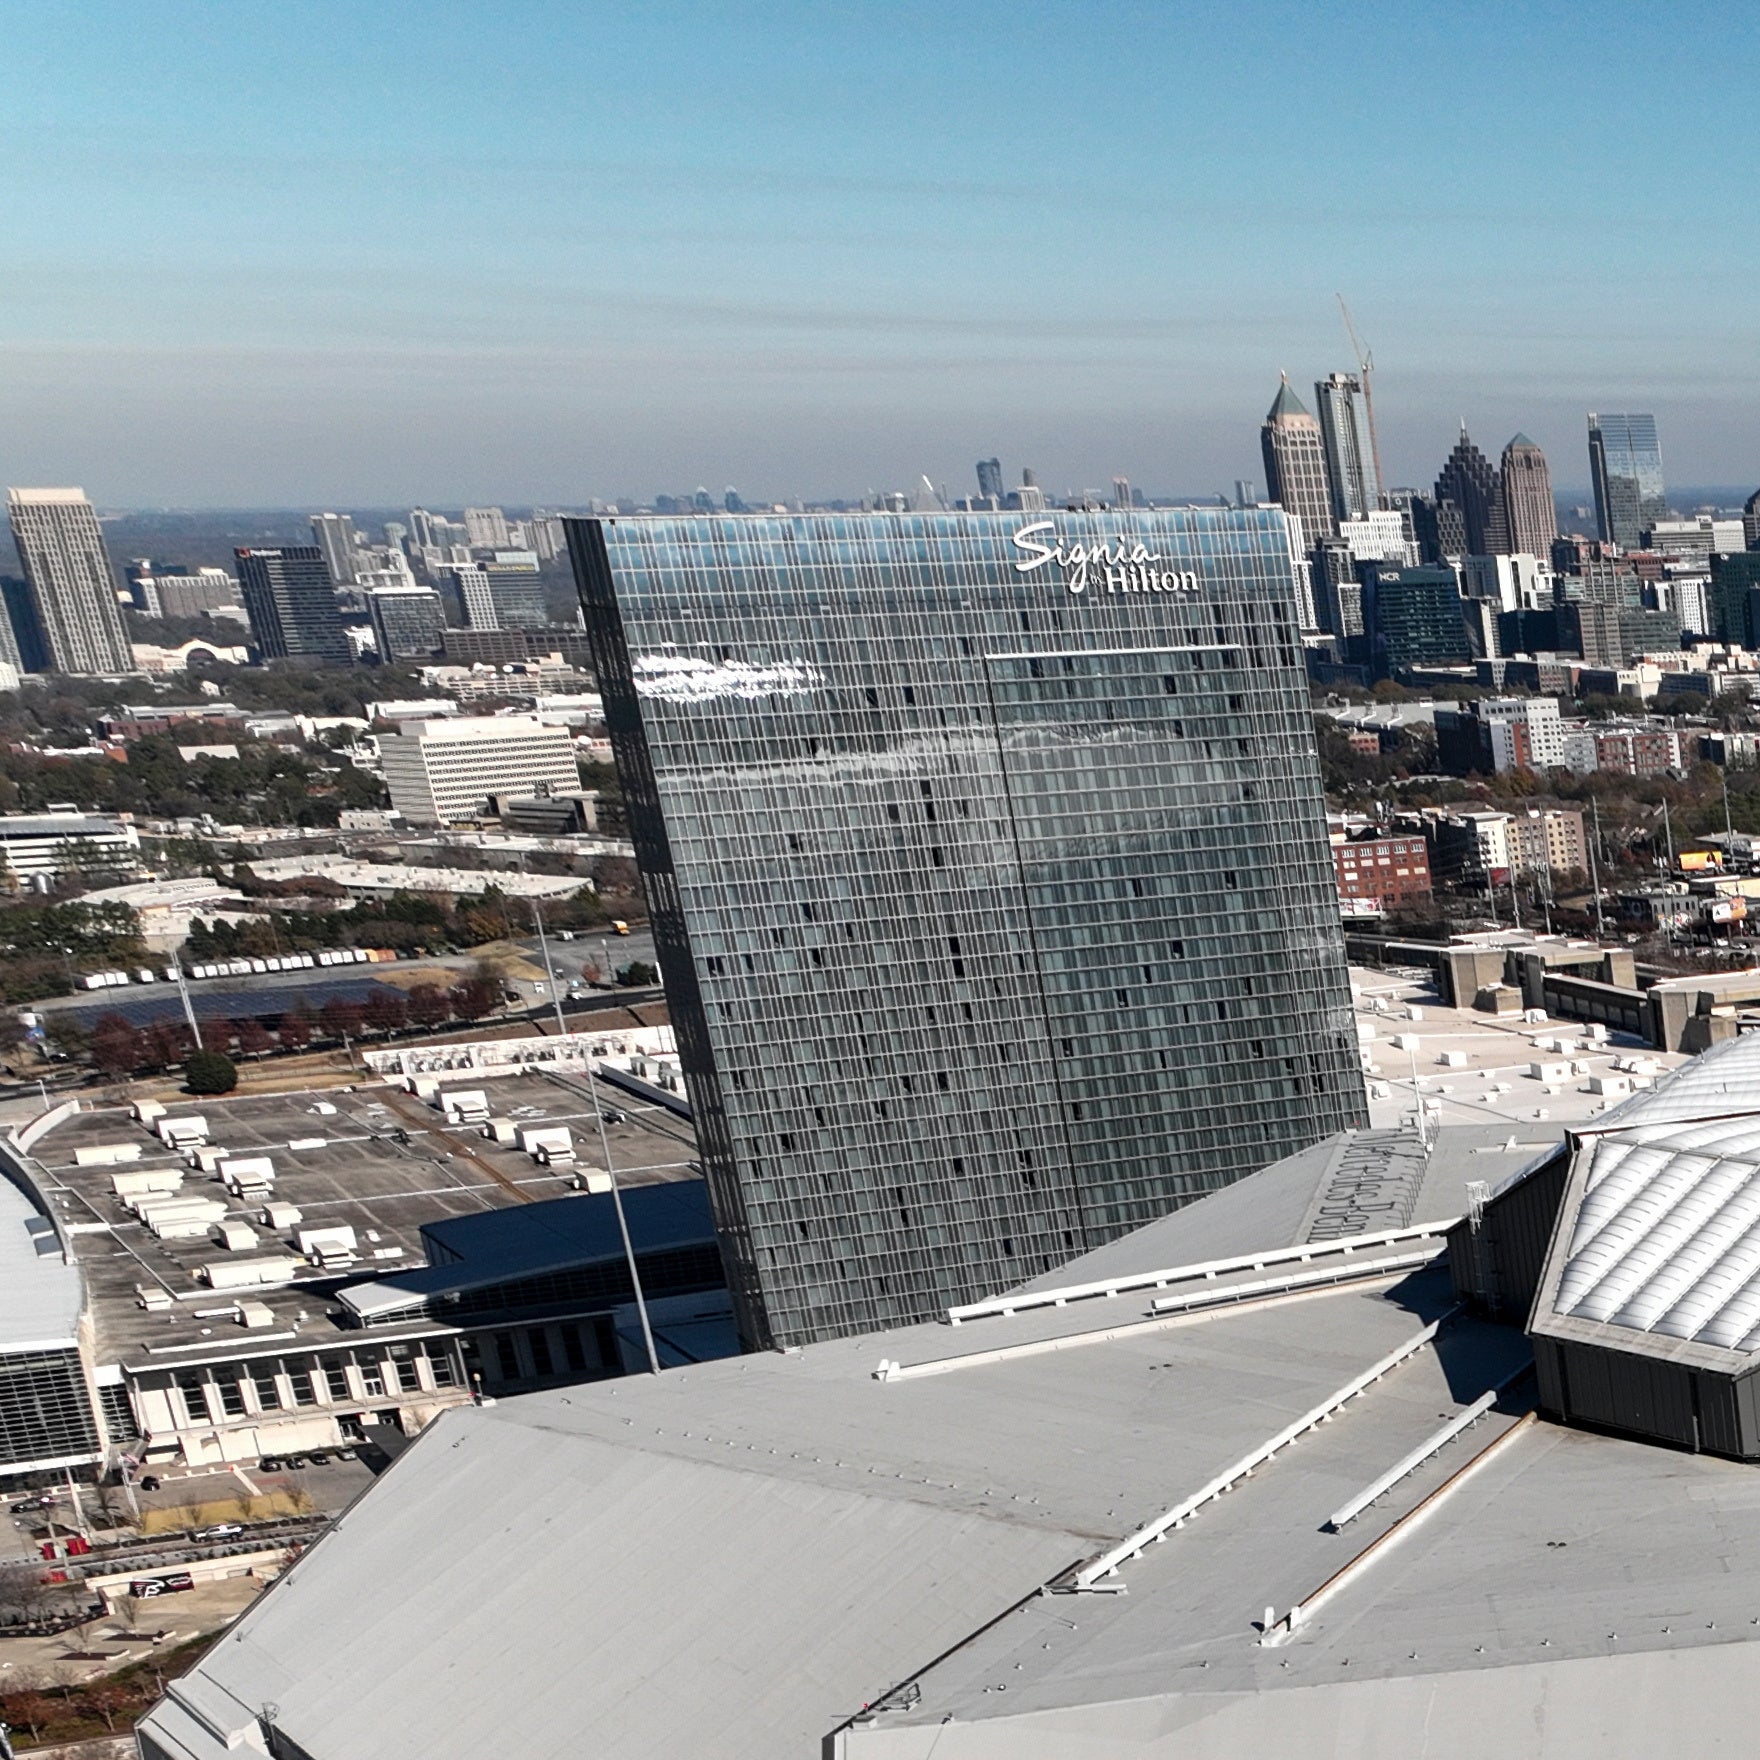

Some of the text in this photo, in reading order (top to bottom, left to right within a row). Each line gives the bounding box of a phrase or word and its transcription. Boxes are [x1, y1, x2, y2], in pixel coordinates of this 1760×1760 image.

[1012, 521, 1161, 594] Signia
[1104, 564, 1199, 594] Hilton
[1378, 571, 1401, 582] NCR
